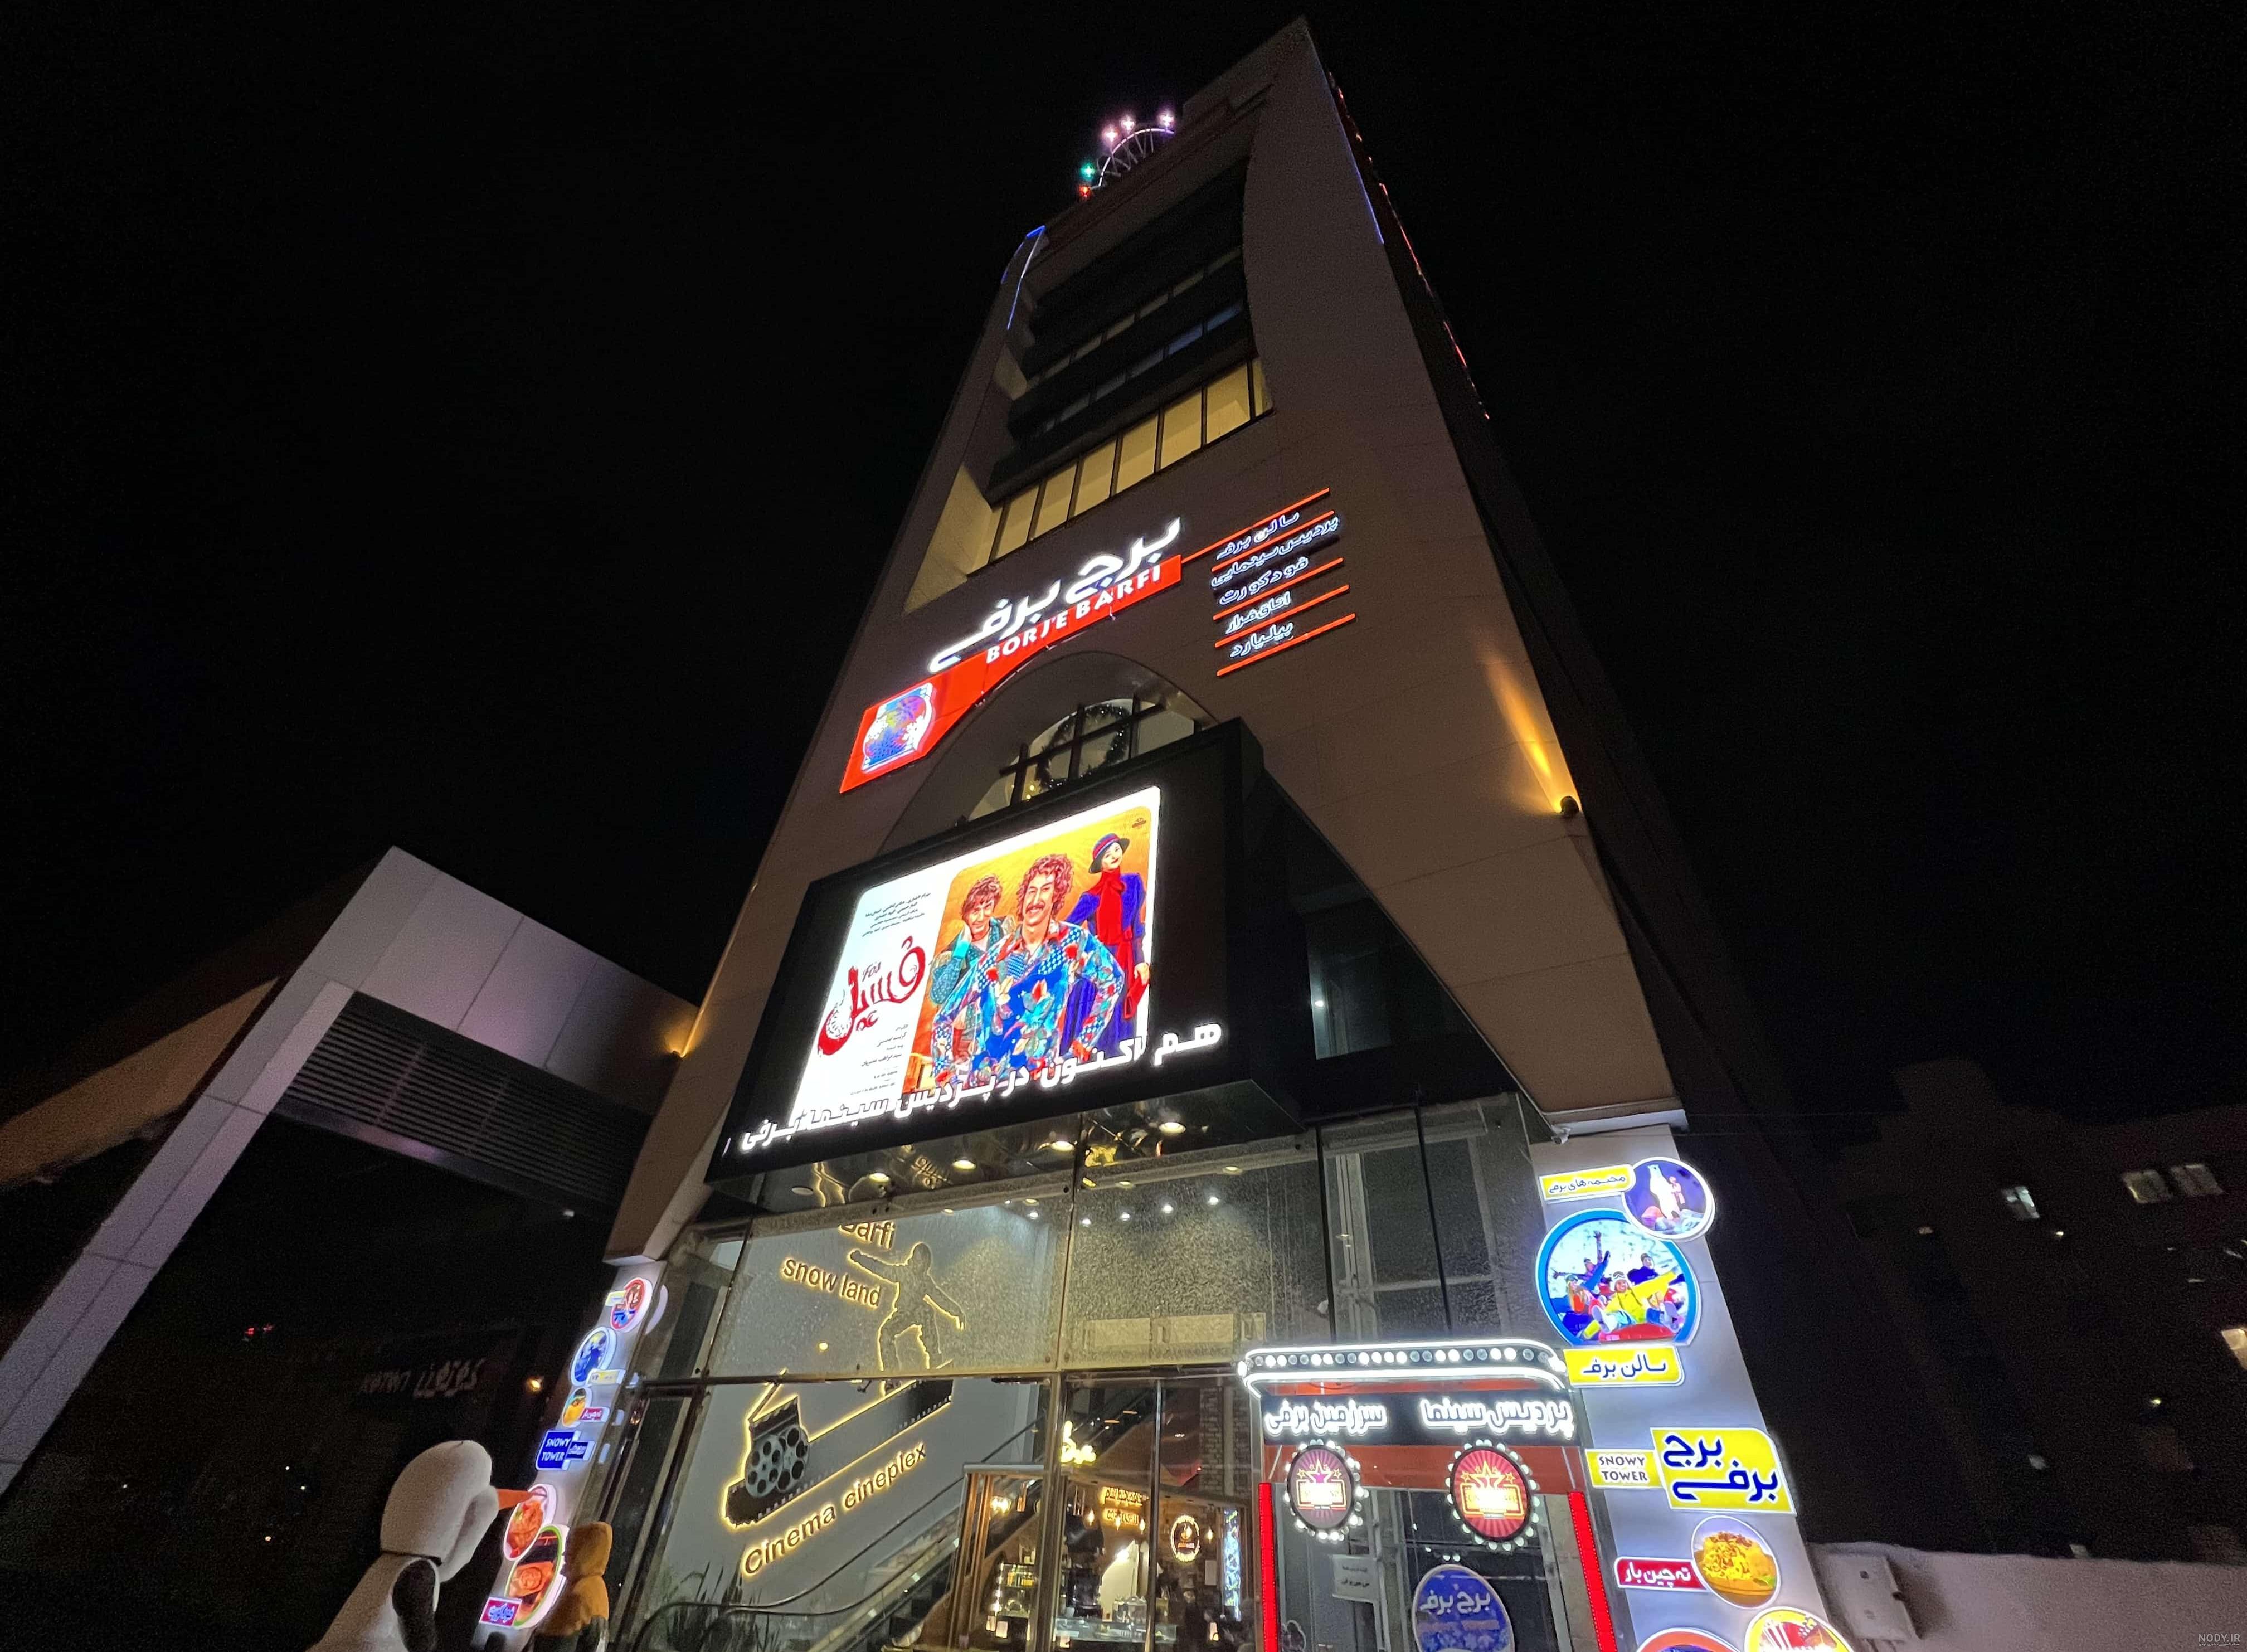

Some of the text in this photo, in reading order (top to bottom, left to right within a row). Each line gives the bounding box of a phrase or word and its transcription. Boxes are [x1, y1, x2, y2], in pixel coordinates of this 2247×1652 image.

[1254, 512, 1300, 542] سالن
[1212, 517, 1339, 587] پردیس سینمایی
[929, 517, 1180, 673] برج برفی
[1076, 565, 1161, 619] BARFI
[1258, 591, 1291, 619] اتاق
[1230, 622, 1293, 658] بیلیارد
[817, 936, 926, 1056] فسیل
[1040, 1036, 1143, 1088] اکنون
[1152, 1023, 1222, 1066] هم
[894, 1073, 996, 1119] پردیس
[1001, 1066, 1030, 1097] در
[740, 1111, 804, 1151] برفی
[783, 1259, 882, 1308] snow land
[1621, 1354, 1666, 1378] سالن
[1264, 1398, 1388, 1436] سرزمین برفی
[1421, 1397, 1575, 1440] پردیس سینما
[541, 1451, 565, 1461] TOWER
[545, 1438, 571, 1447] SNOWY
[1598, 1456, 1646, 1466] SNOWY
[1601, 1470, 1648, 1481] TOWER
[1662, 1434, 1778, 1502] برج برفی
[744, 1442, 927, 1575] Cinema cineplex
[1625, 1561, 1642, 1584] بار
[1456, 1591, 1491, 1614] برج
